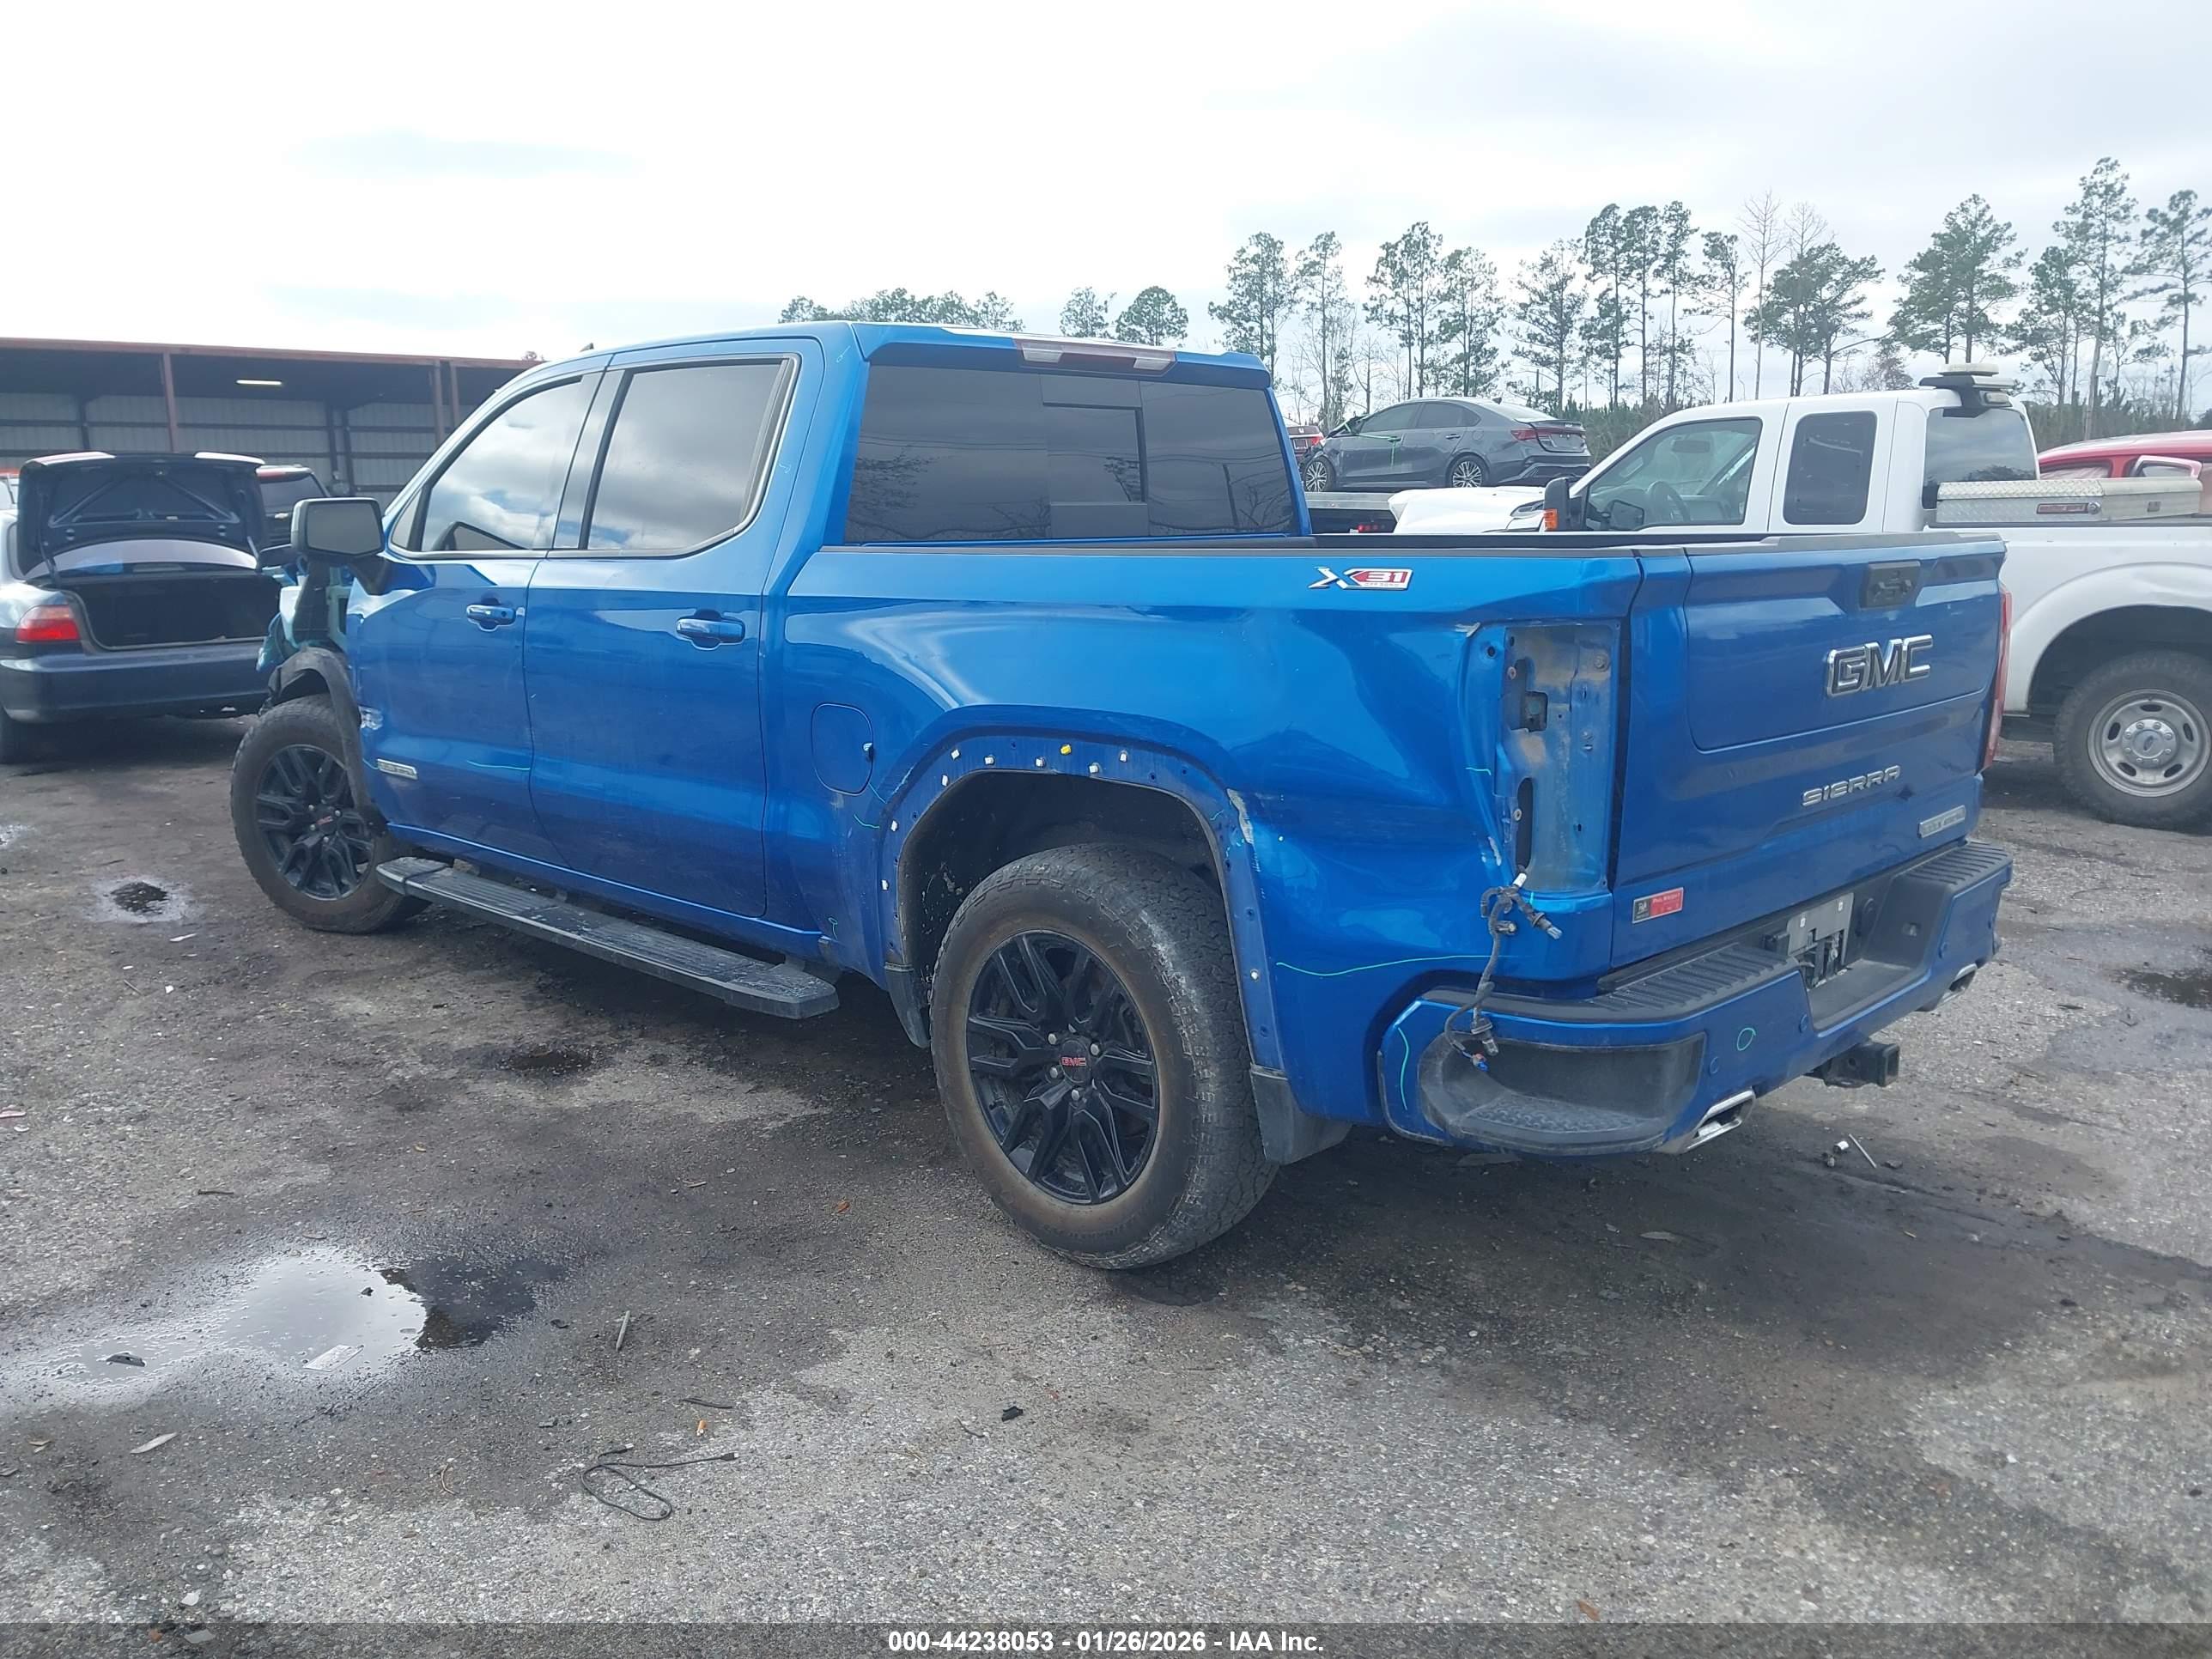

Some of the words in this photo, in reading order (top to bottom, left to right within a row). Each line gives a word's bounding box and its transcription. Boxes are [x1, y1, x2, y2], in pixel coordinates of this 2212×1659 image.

[1308, 567, 1413, 590] X31
[1826, 634, 1934, 697] GMC
[1802, 764, 1900, 806] SIERRA
[1061, 1056, 1086, 1066] GMC
